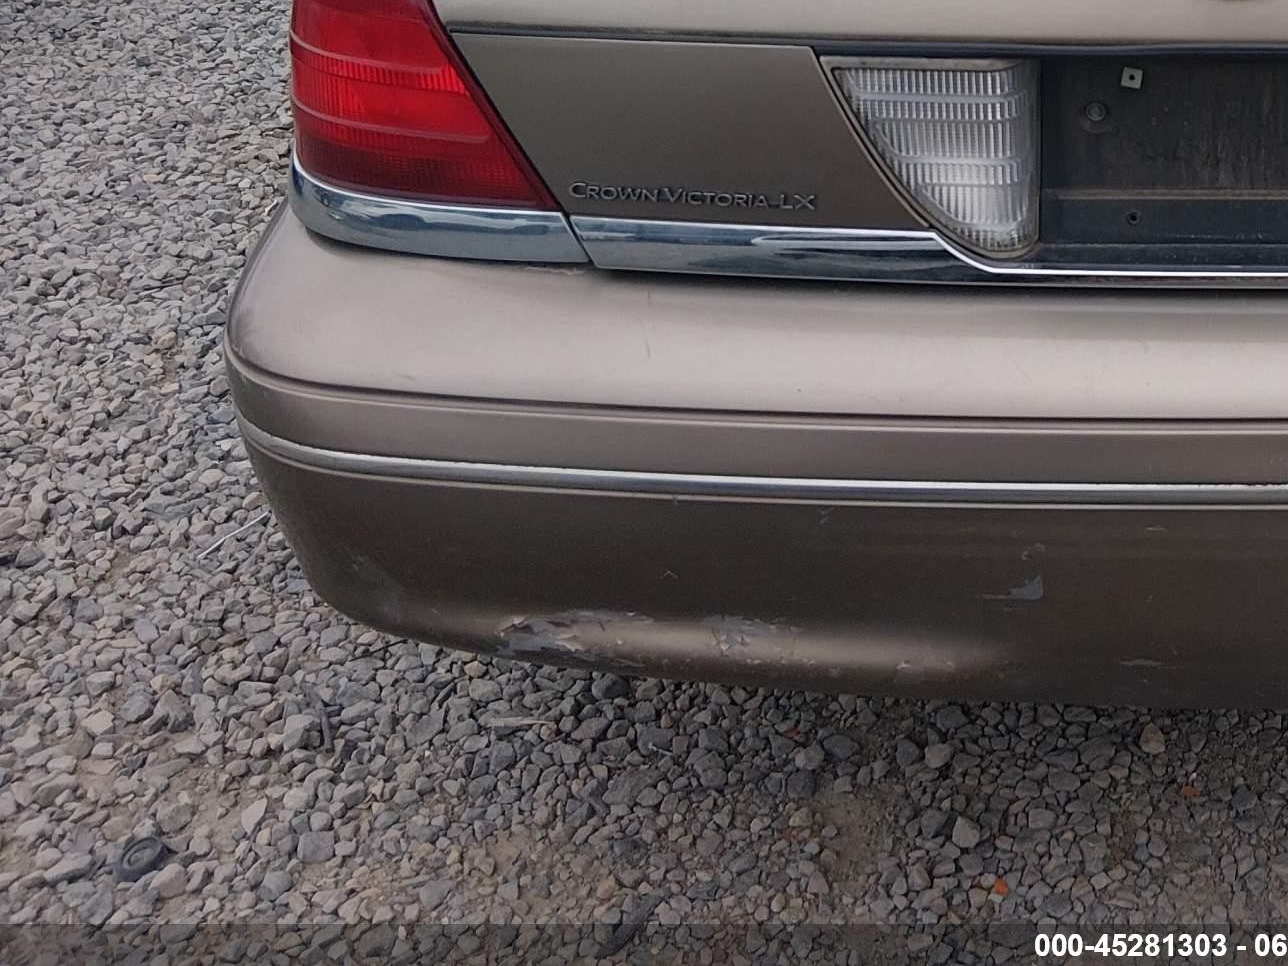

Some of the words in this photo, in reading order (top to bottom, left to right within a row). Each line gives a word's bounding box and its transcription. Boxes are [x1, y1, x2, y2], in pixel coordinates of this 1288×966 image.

[568, 182, 658, 203] CROWN
[662, 186, 769, 210] VICTORIA
[779, 193, 816, 211] LX
